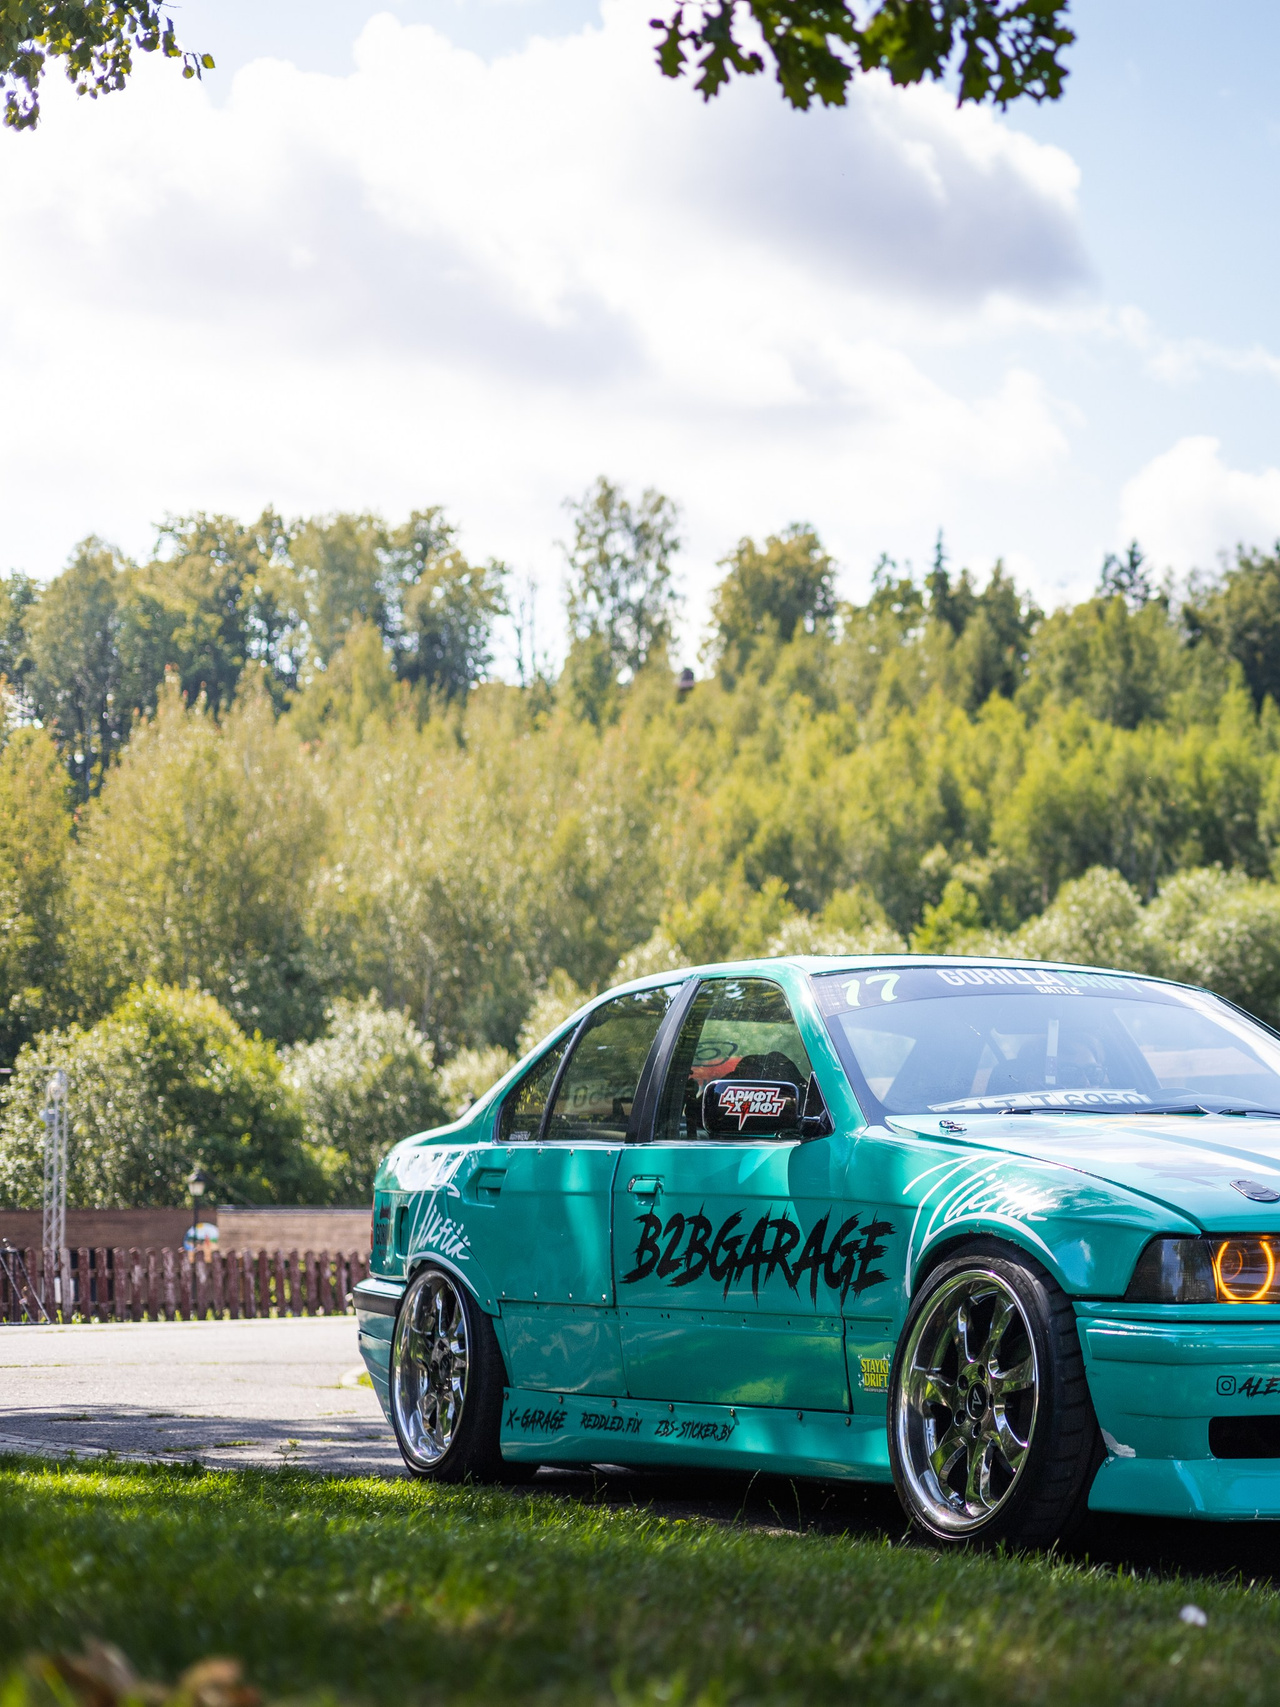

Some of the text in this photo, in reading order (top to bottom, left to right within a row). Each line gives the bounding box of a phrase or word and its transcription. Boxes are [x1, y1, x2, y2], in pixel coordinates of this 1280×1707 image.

[841, 973, 901, 1007] 17
[936, 968, 1144, 993] GORILLA DRIFT
[1034, 985, 1084, 995] BATTLE
[722, 1090, 775, 1103] ДРИФТ
[619, 1202, 897, 1312] B2BGARAGE
[860, 1359, 889, 1374] STAYKI
[863, 1373, 888, 1388] DRIFT
[505, 1407, 568, 1435] X-GARAGE
